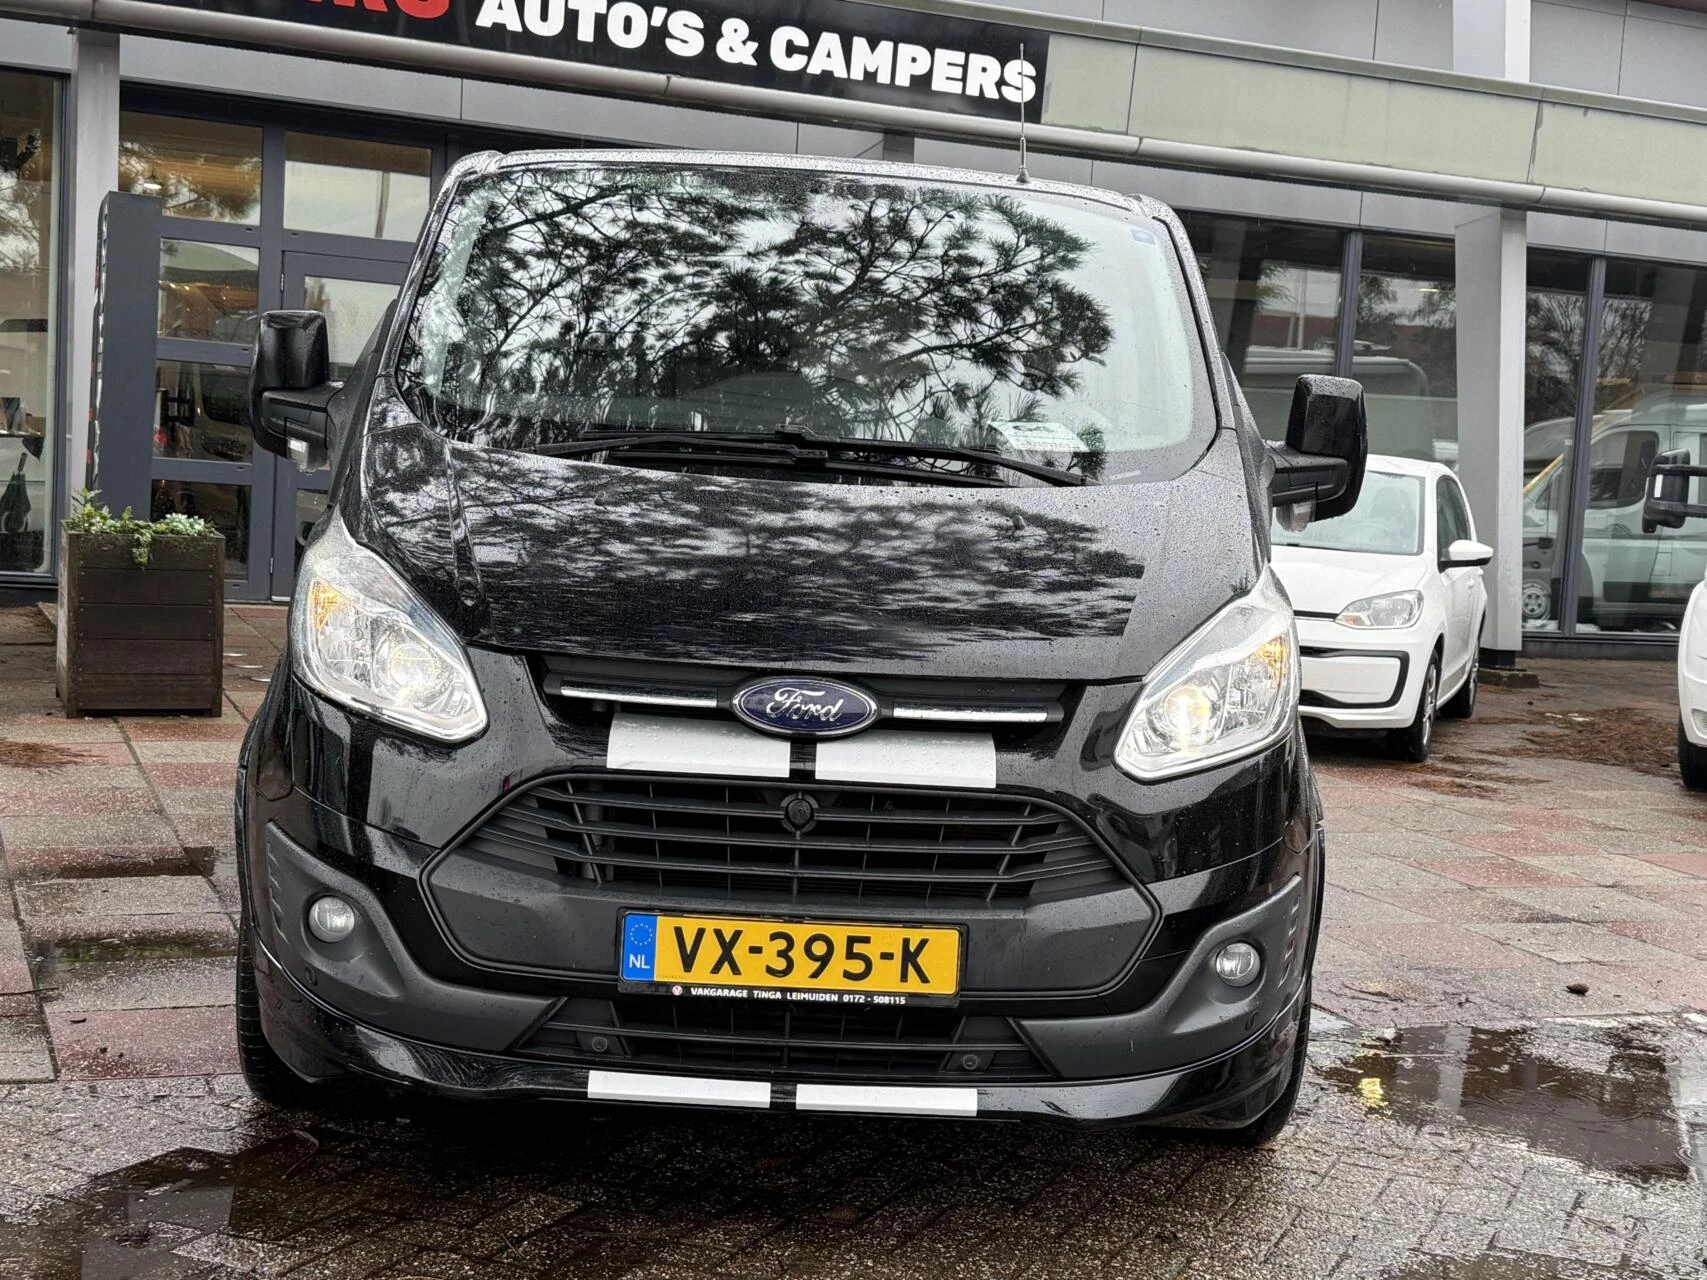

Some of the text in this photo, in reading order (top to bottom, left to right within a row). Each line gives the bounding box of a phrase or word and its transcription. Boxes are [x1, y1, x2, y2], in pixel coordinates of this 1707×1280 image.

[475, 0, 1037, 103] AUTO'S & CAMPERS
[766, 687, 844, 722] Ford
[628, 953, 650, 969] NL
[673, 926, 931, 984] VX-395-K
[690, 987, 748, 998] VAKGARAGE
[753, 990, 782, 999] TINGA
[786, 991, 839, 1002] LEIMUIDEN
[843, 994, 865, 1003] 0172
